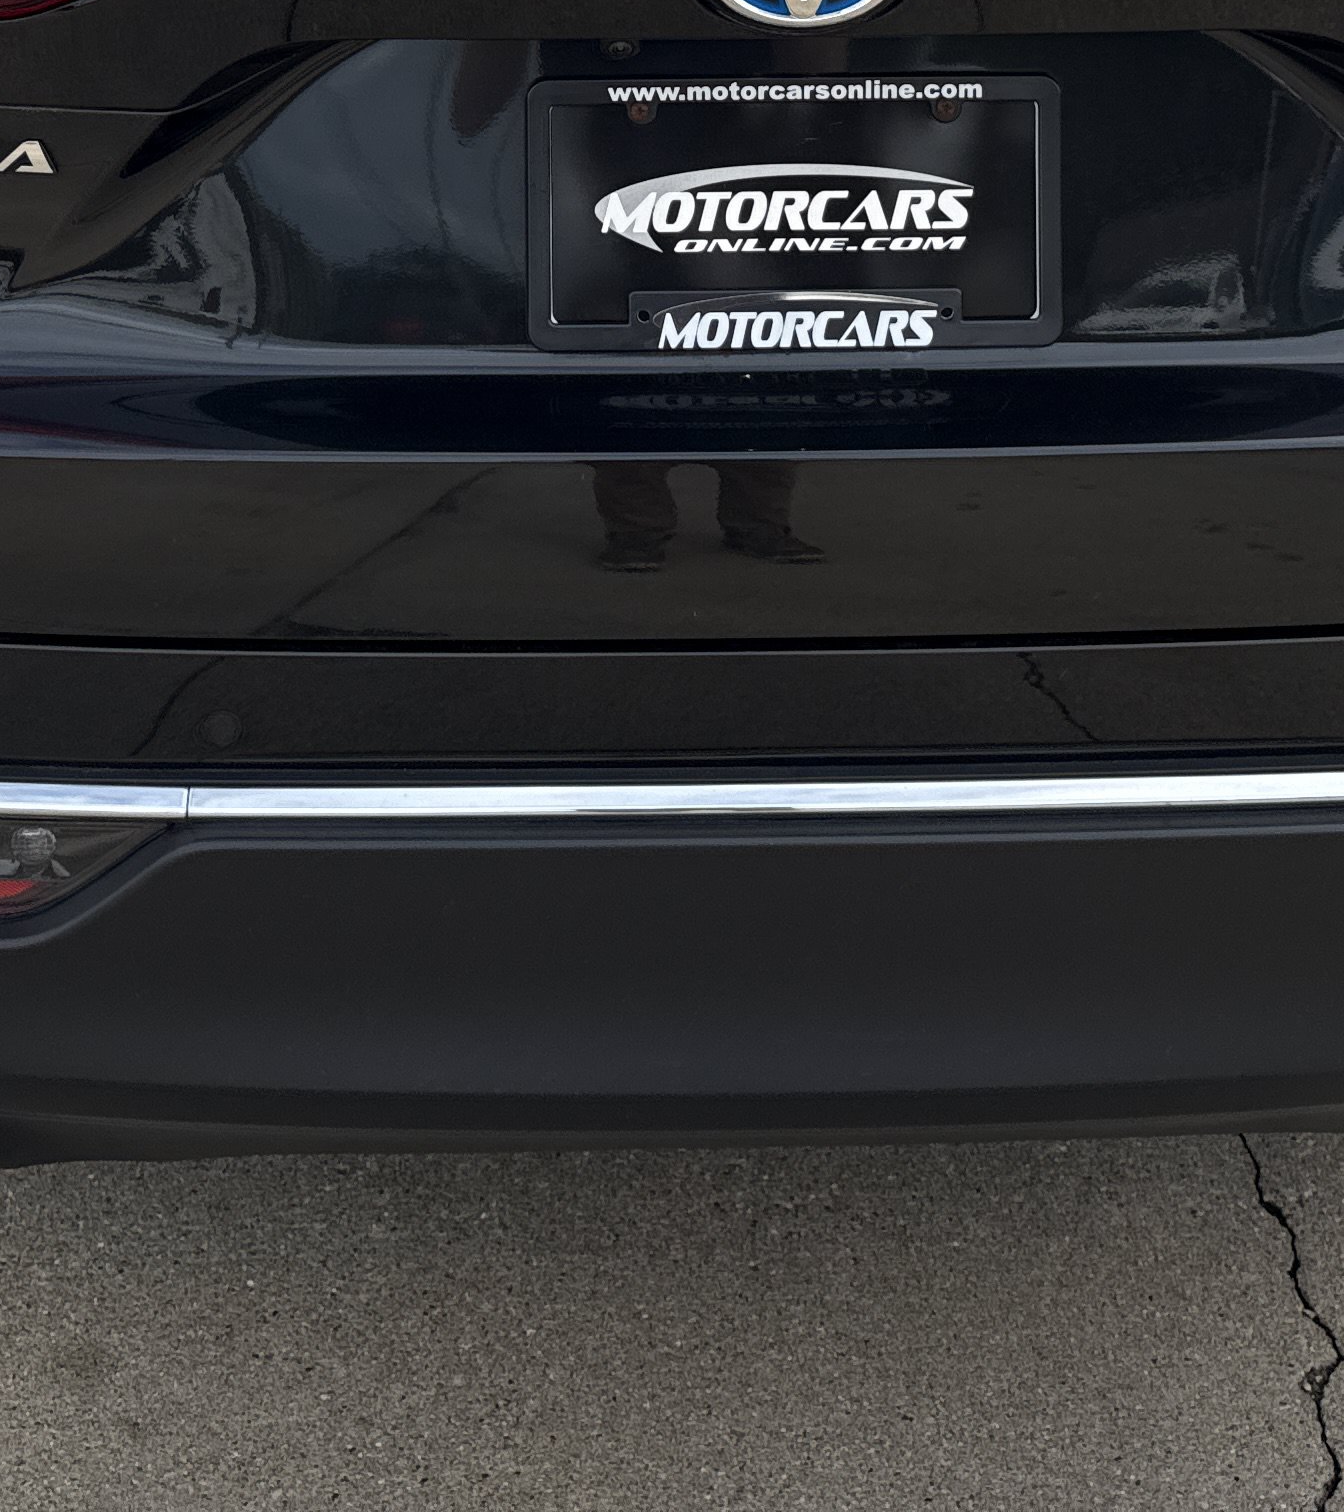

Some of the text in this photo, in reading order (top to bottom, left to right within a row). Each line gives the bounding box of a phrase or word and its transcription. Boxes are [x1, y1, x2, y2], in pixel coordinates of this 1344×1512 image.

[608, 80, 983, 102] www.motorcarsonline.com
[601, 188, 974, 234] MOTORCARS
[673, 235, 968, 253] ONLINE.COM
[658, 309, 939, 349] MOTORCARS
